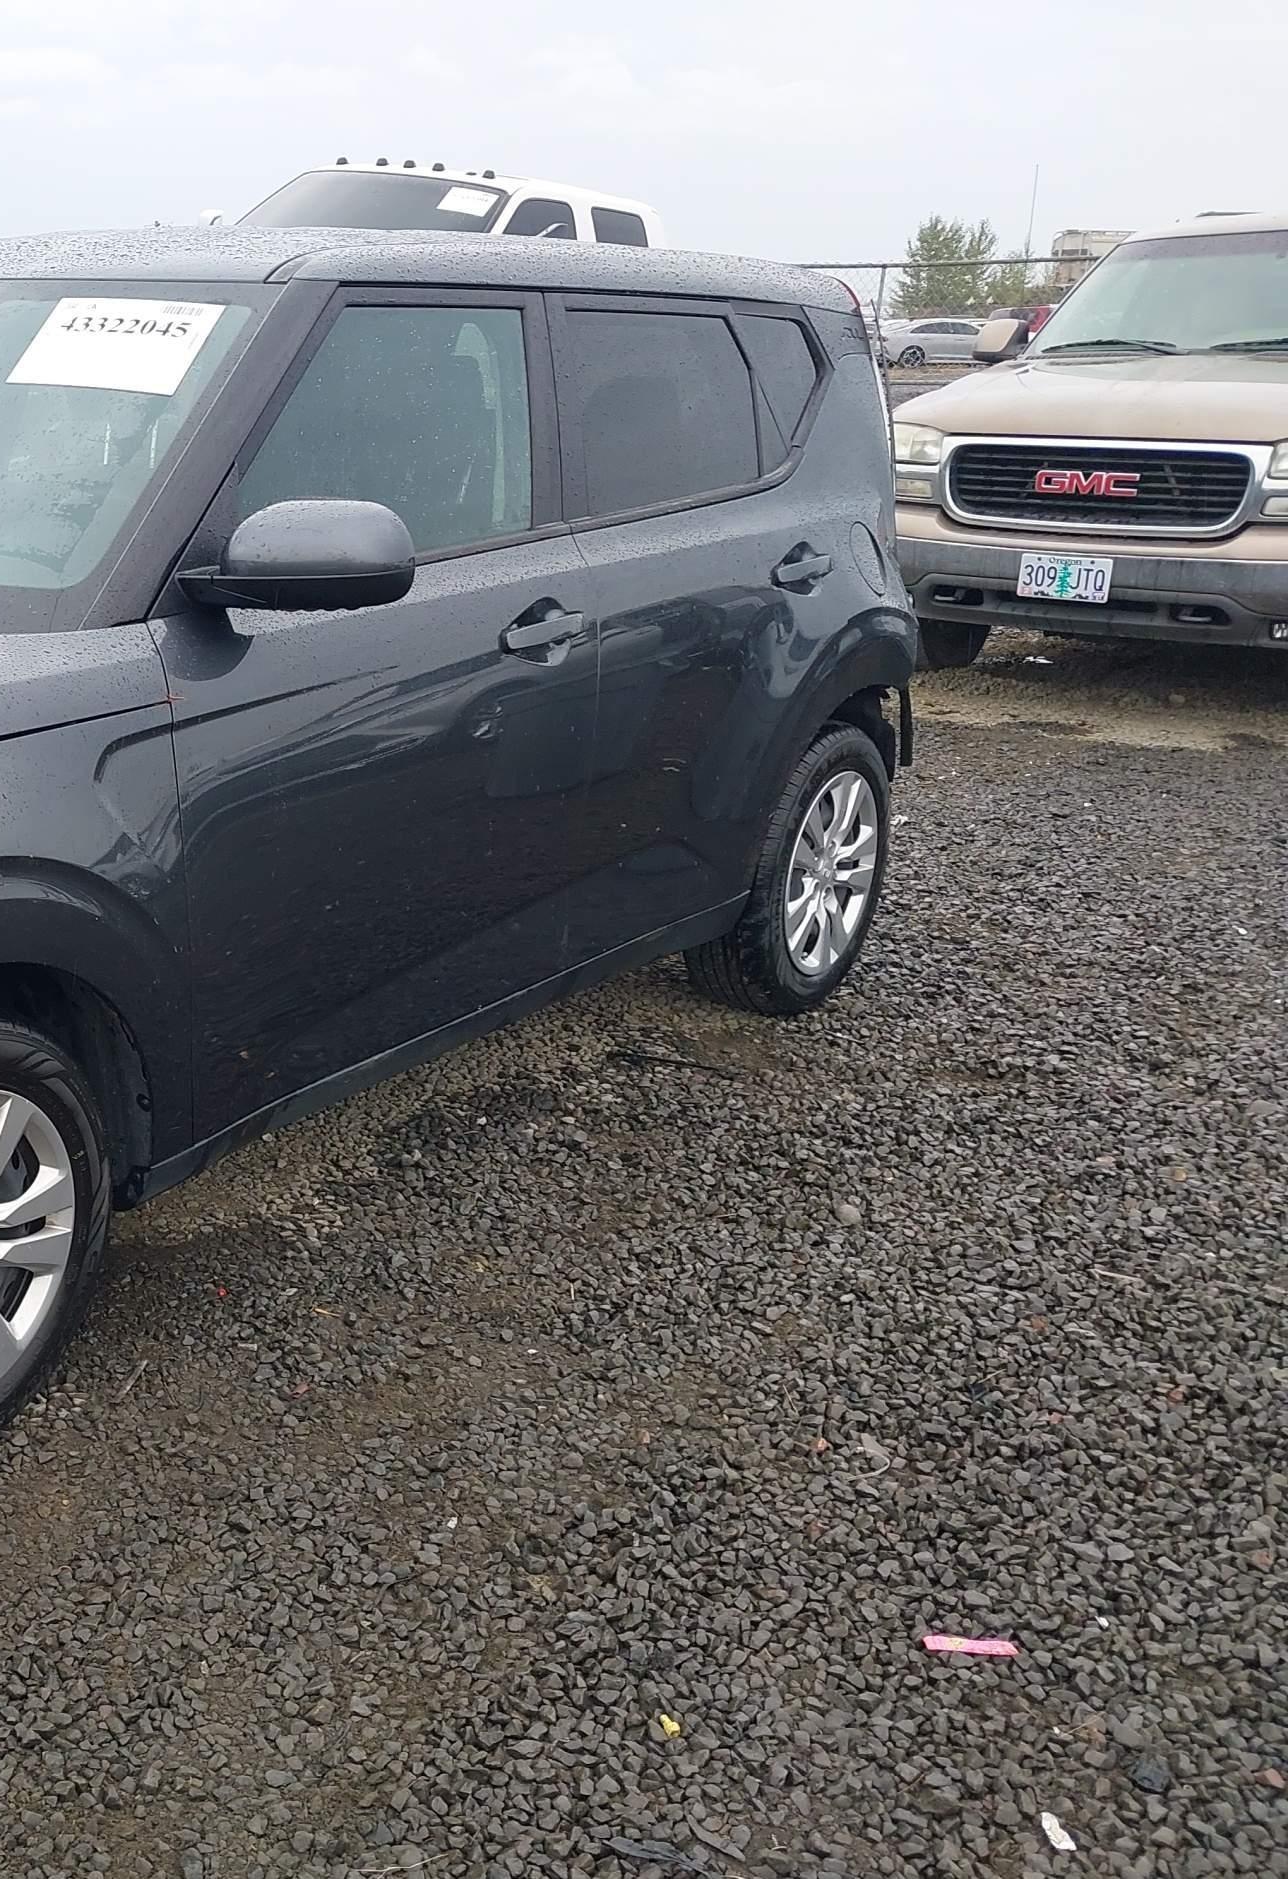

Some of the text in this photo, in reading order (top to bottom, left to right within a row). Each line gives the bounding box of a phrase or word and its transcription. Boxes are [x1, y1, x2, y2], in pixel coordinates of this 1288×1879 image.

[61, 316, 192, 338] 43322045
[1035, 469, 1140, 497] GMC
[1049, 557, 1082, 566] Oregon
[1022, 564, 1106, 592] 309 JTQ
